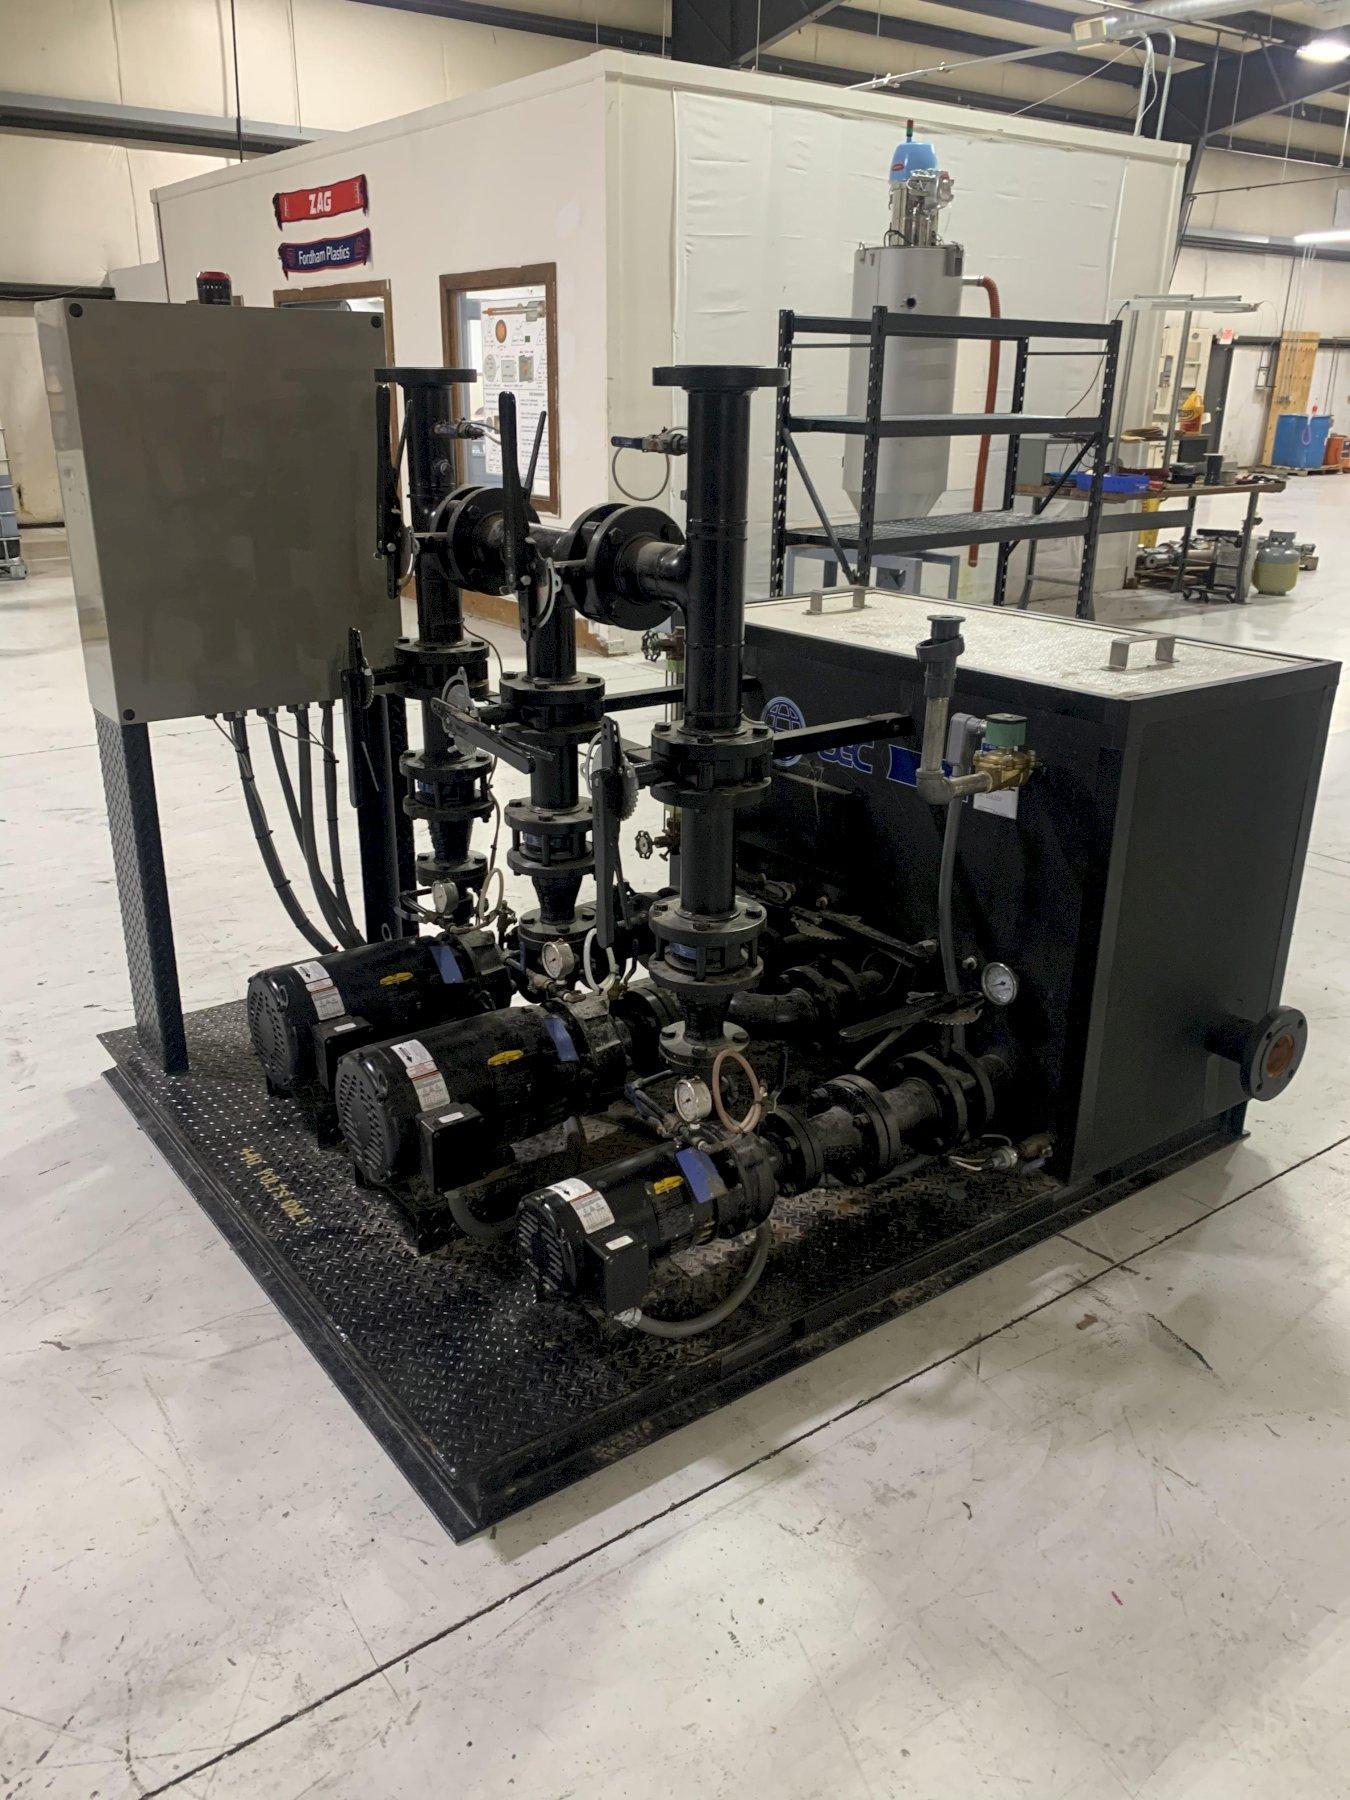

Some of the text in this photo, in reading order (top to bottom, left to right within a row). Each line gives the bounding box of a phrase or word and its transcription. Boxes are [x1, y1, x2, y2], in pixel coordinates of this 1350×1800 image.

[309, 191, 331, 214] ZAG
[298, 245, 350, 265] Fordham Plastics
[256, 1168, 290, 1199] VOLTS
[280, 1199, 314, 1226] ONLY
